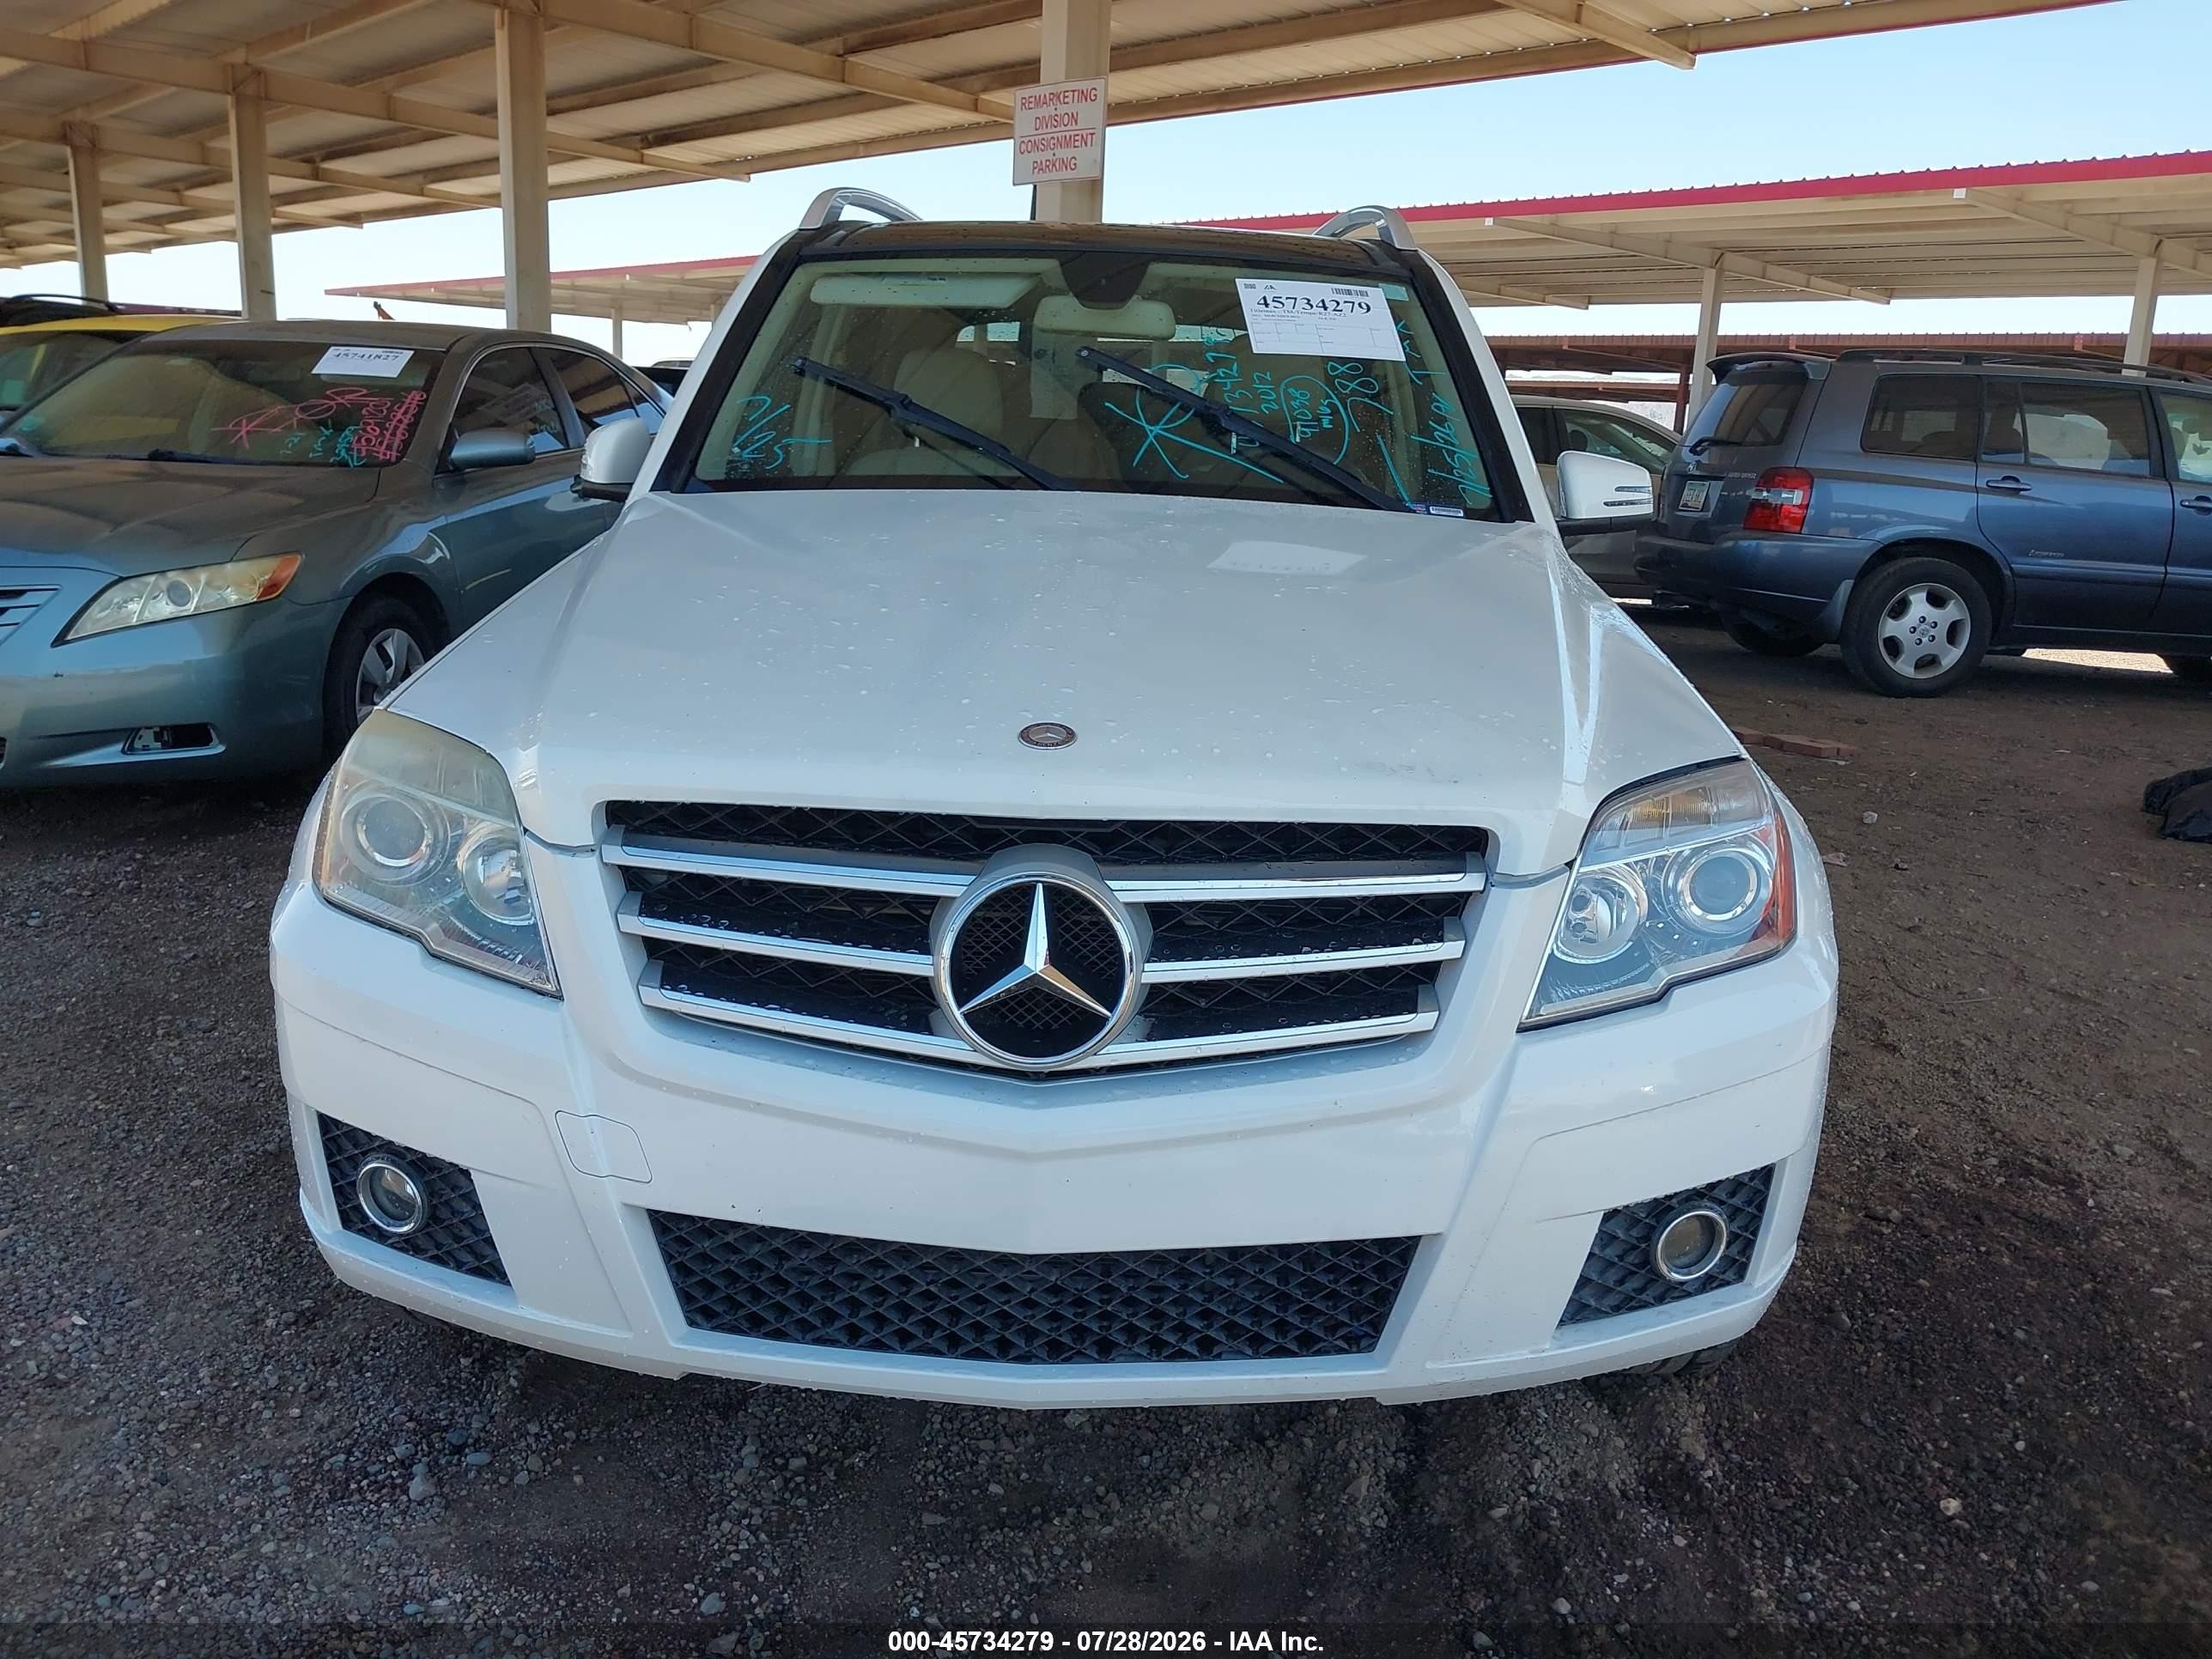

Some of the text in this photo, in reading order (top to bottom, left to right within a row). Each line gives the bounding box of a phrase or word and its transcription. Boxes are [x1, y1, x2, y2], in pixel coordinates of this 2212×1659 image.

[1020, 88, 1098, 111] REMARKETING
[1034, 112, 1079, 131] DIVISION
[1018, 132, 1097, 155] CONSIGNMENT
[1032, 156, 1078, 175] PARKING
[1256, 295, 1371, 315] 45734279
[332, 351, 399, 362] 45741827
[1251, 371, 1279, 415] 2012
[1326, 360, 1394, 433] 788
